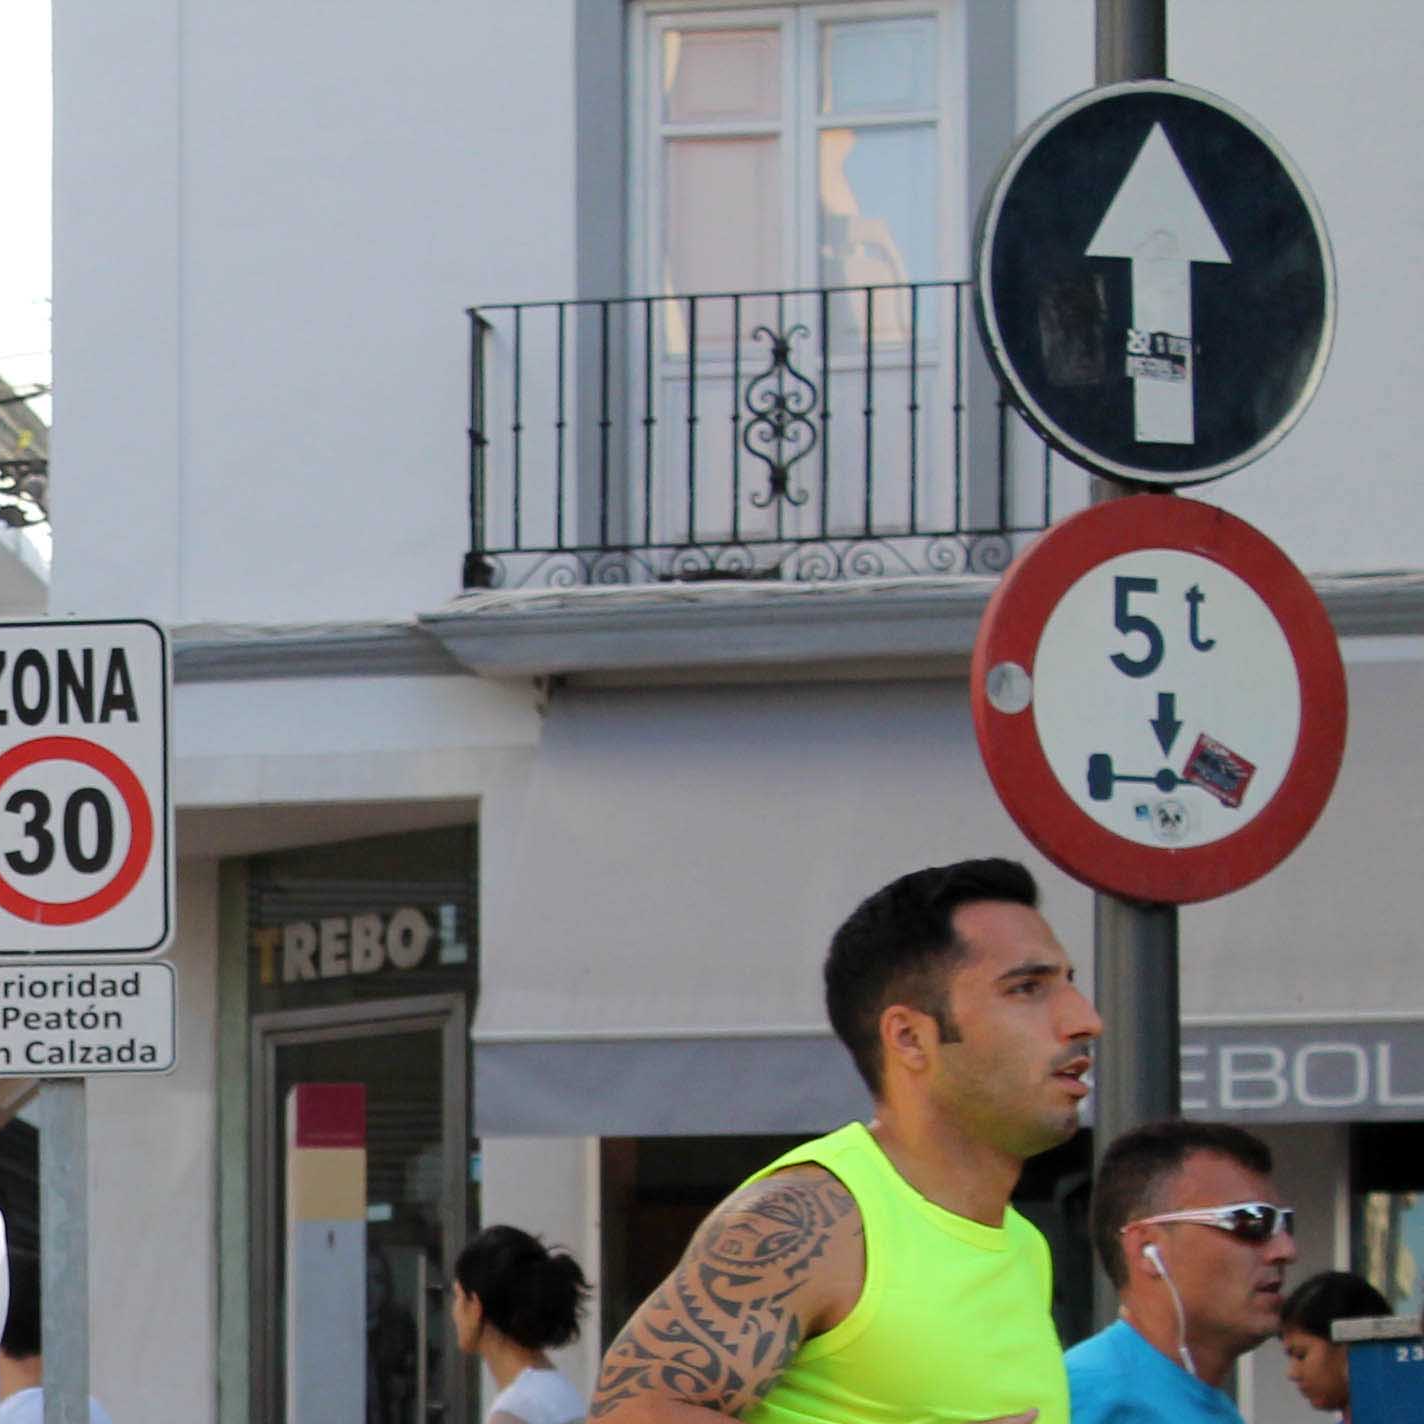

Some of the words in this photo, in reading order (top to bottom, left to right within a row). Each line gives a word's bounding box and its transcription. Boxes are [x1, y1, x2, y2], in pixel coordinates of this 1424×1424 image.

[1109, 575, 1166, 678] 5
[1184, 582, 1217, 653] t
[3, 786, 116, 876] 30
[255, 904, 467, 984] TREBOL
[1, 1003, 123, 1031] Peatón
[25, 1039, 158, 1066] Calzada
